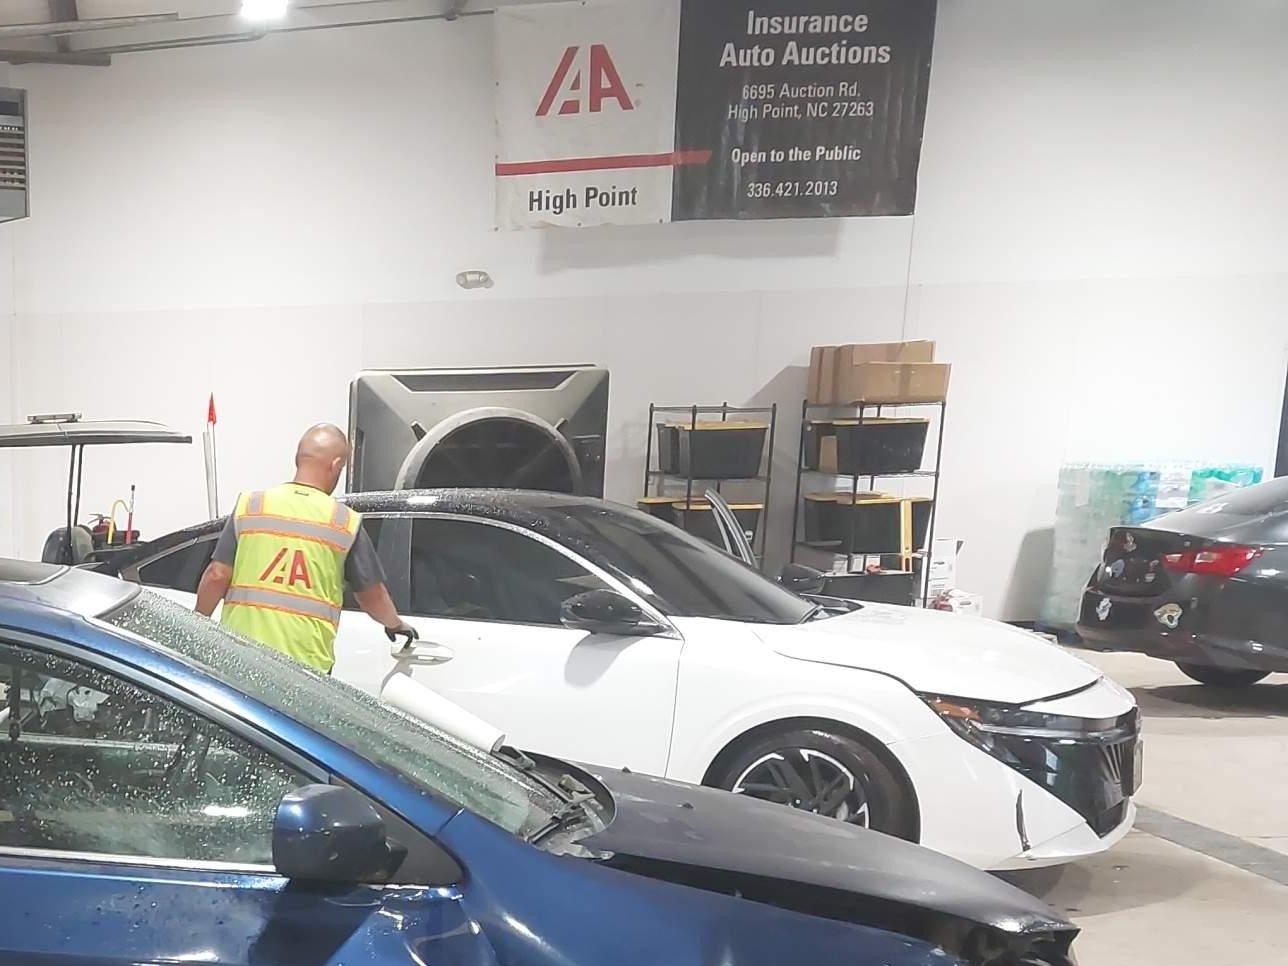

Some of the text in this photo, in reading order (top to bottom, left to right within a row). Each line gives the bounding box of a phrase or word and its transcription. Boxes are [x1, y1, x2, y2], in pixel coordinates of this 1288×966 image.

[746, 10, 869, 35] Insurance
[719, 39, 892, 67] Auto Auctions
[742, 81, 861, 100] 6695 Auction Rd.
[727, 101, 874, 122] High Point, NC 27263
[731, 145, 862, 167] Open to the Public
[528, 185, 638, 215] High Point
[746, 181, 838, 198] 336.421.2013
